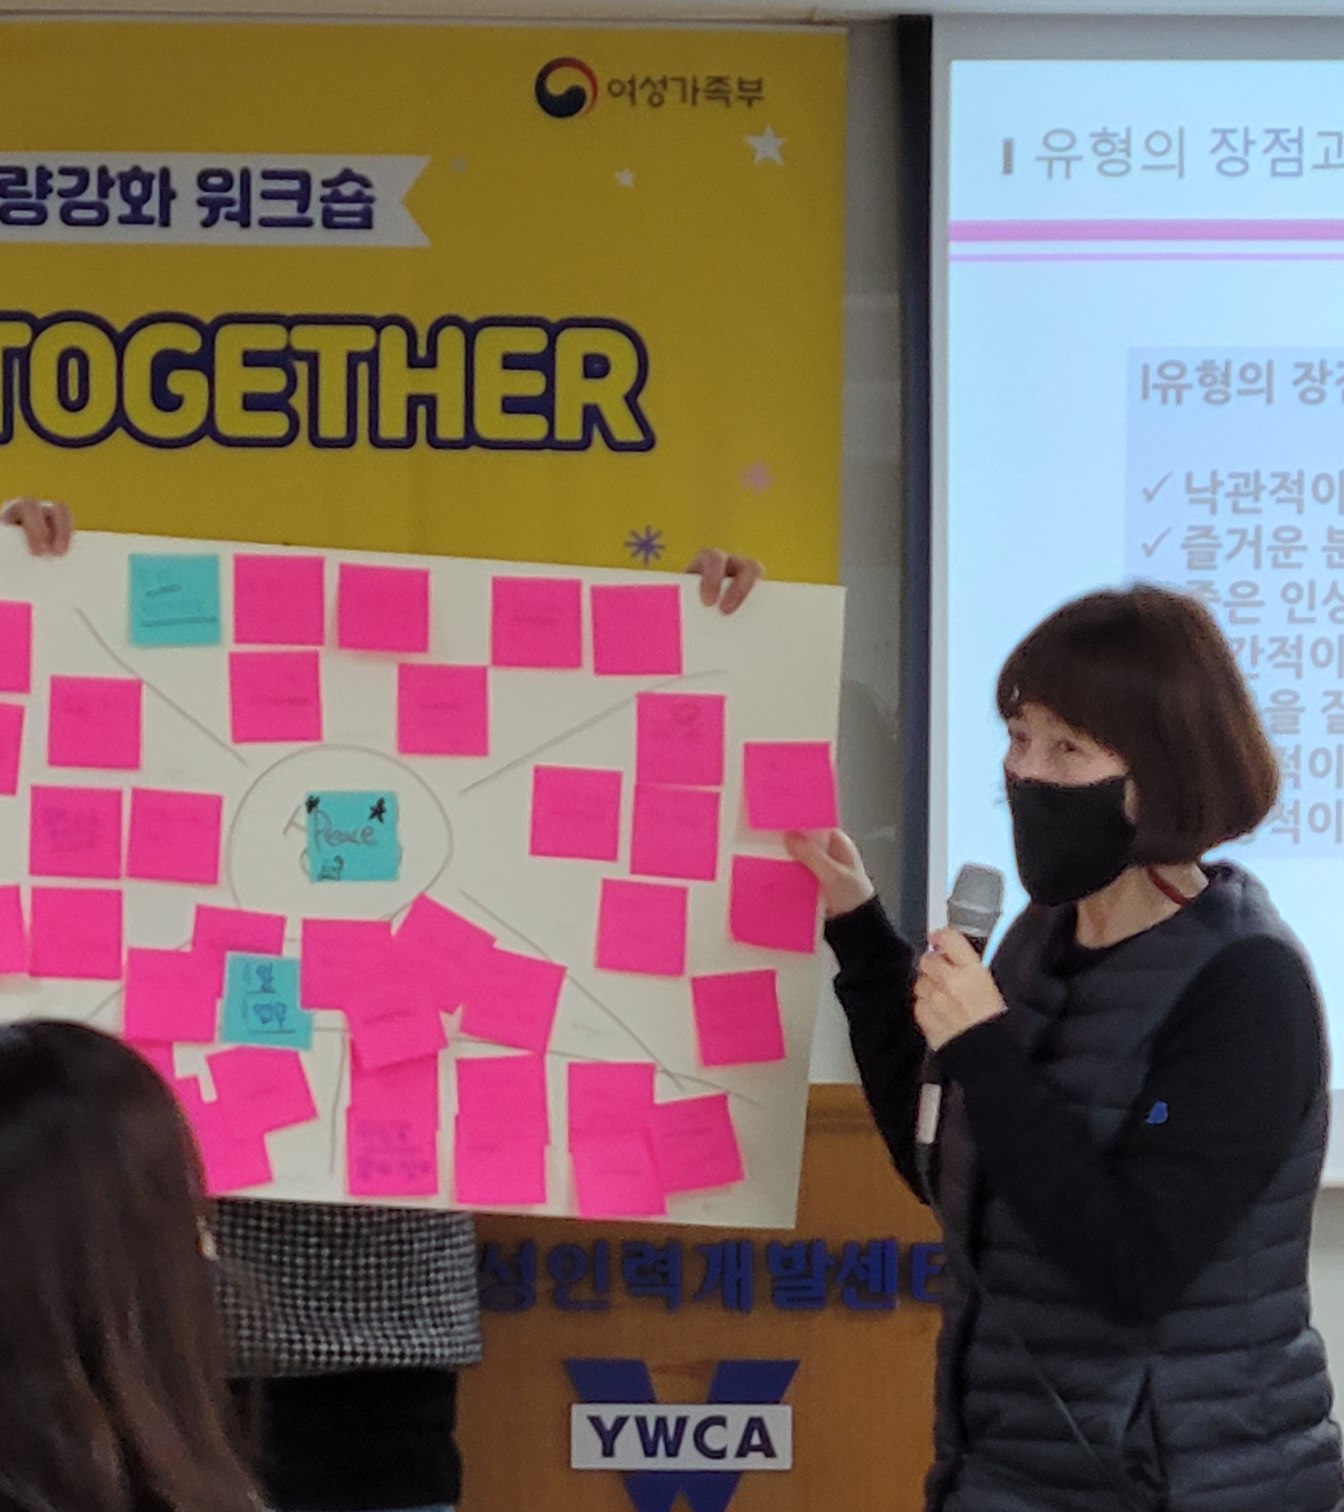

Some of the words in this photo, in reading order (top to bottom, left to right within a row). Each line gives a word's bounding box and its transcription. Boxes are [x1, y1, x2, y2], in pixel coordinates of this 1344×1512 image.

[606, 73, 766, 109] 여성가족부
[1035, 126, 1186, 178] 유형의
[196, 168, 376, 231] 워크숍
[1181, 524, 1308, 570] 즐거운
[587, 1415, 777, 1459] YWCA
